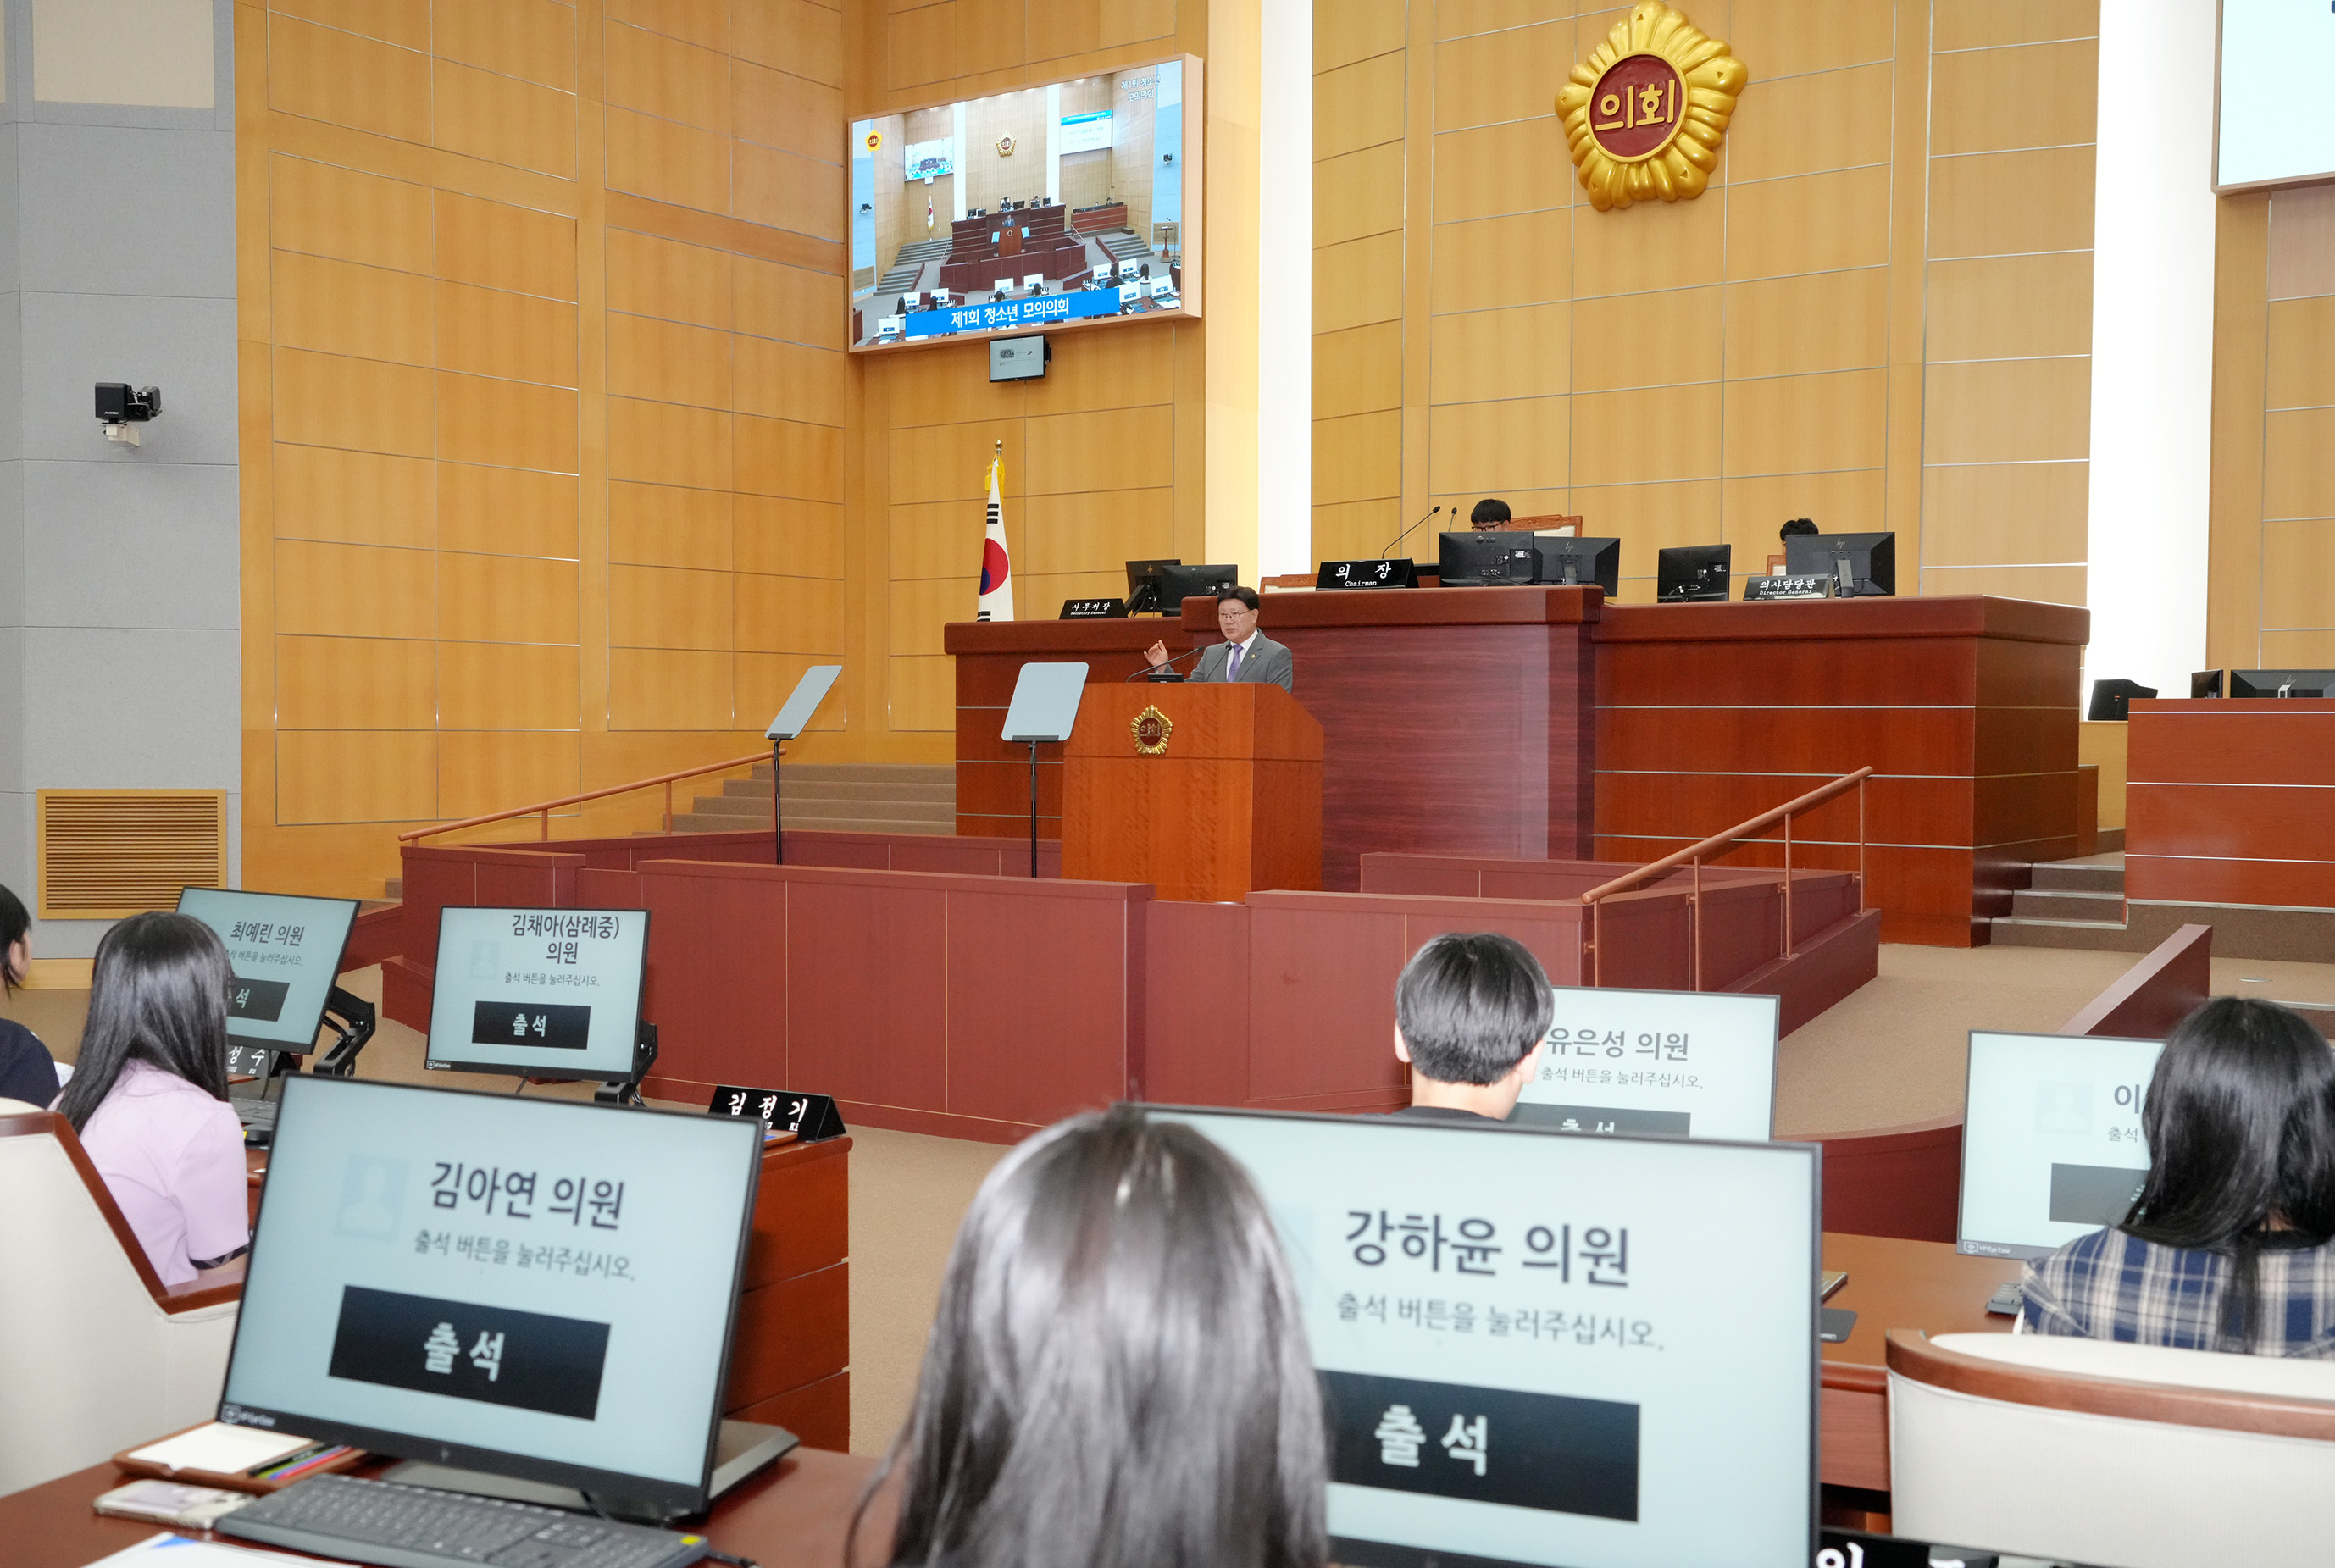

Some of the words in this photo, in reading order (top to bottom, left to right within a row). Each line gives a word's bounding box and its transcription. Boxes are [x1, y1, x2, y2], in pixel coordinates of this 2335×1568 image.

[1595, 79, 1676, 131] 의회
[951, 308, 979, 329] 제1회
[984, 303, 1018, 324] 청소년
[1023, 297, 1069, 319] 모의의회
[1759, 579, 1816, 590] 의사담당관
[230, 921, 274, 944] 최예린
[275, 925, 305, 947] 의원
[512, 914, 620, 940] 김채아(삼례중)
[237, 950, 259, 963] 버튼을
[259, 952, 302, 967] 눌러주십시오.
[546, 942, 579, 964] 의원
[505, 972, 521, 984] 출석
[523, 973, 546, 985] 버튼을
[549, 974, 600, 987] 눌러주십시오.
[513, 1013, 546, 1038] 출석
[1546, 1028, 1626, 1058] 유은성
[1635, 1032, 1689, 1061] 의원
[1540, 1067, 1567, 1081] 출석
[1572, 1068, 1612, 1084] 버튼을
[1617, 1071, 1704, 1089] 눌러주십시오.
[2107, 1126, 2138, 1144] 출석
[430, 1162, 537, 1220] 김아연
[548, 1177, 625, 1230] 의원
[414, 1229, 451, 1255] 출석
[456, 1234, 510, 1265] 버튼을
[516, 1243, 635, 1282] 눌러주십시오.
[1345, 1210, 1503, 1277] 강하윤
[1522, 1223, 1628, 1288] 의원
[1336, 1292, 1387, 1324] 출석
[1397, 1297, 1477, 1334] 버튼을
[1485, 1305, 1664, 1352] 눌러주십시오.
[424, 1321, 505, 1382] 출석
[1374, 1403, 1489, 1477] 출석
